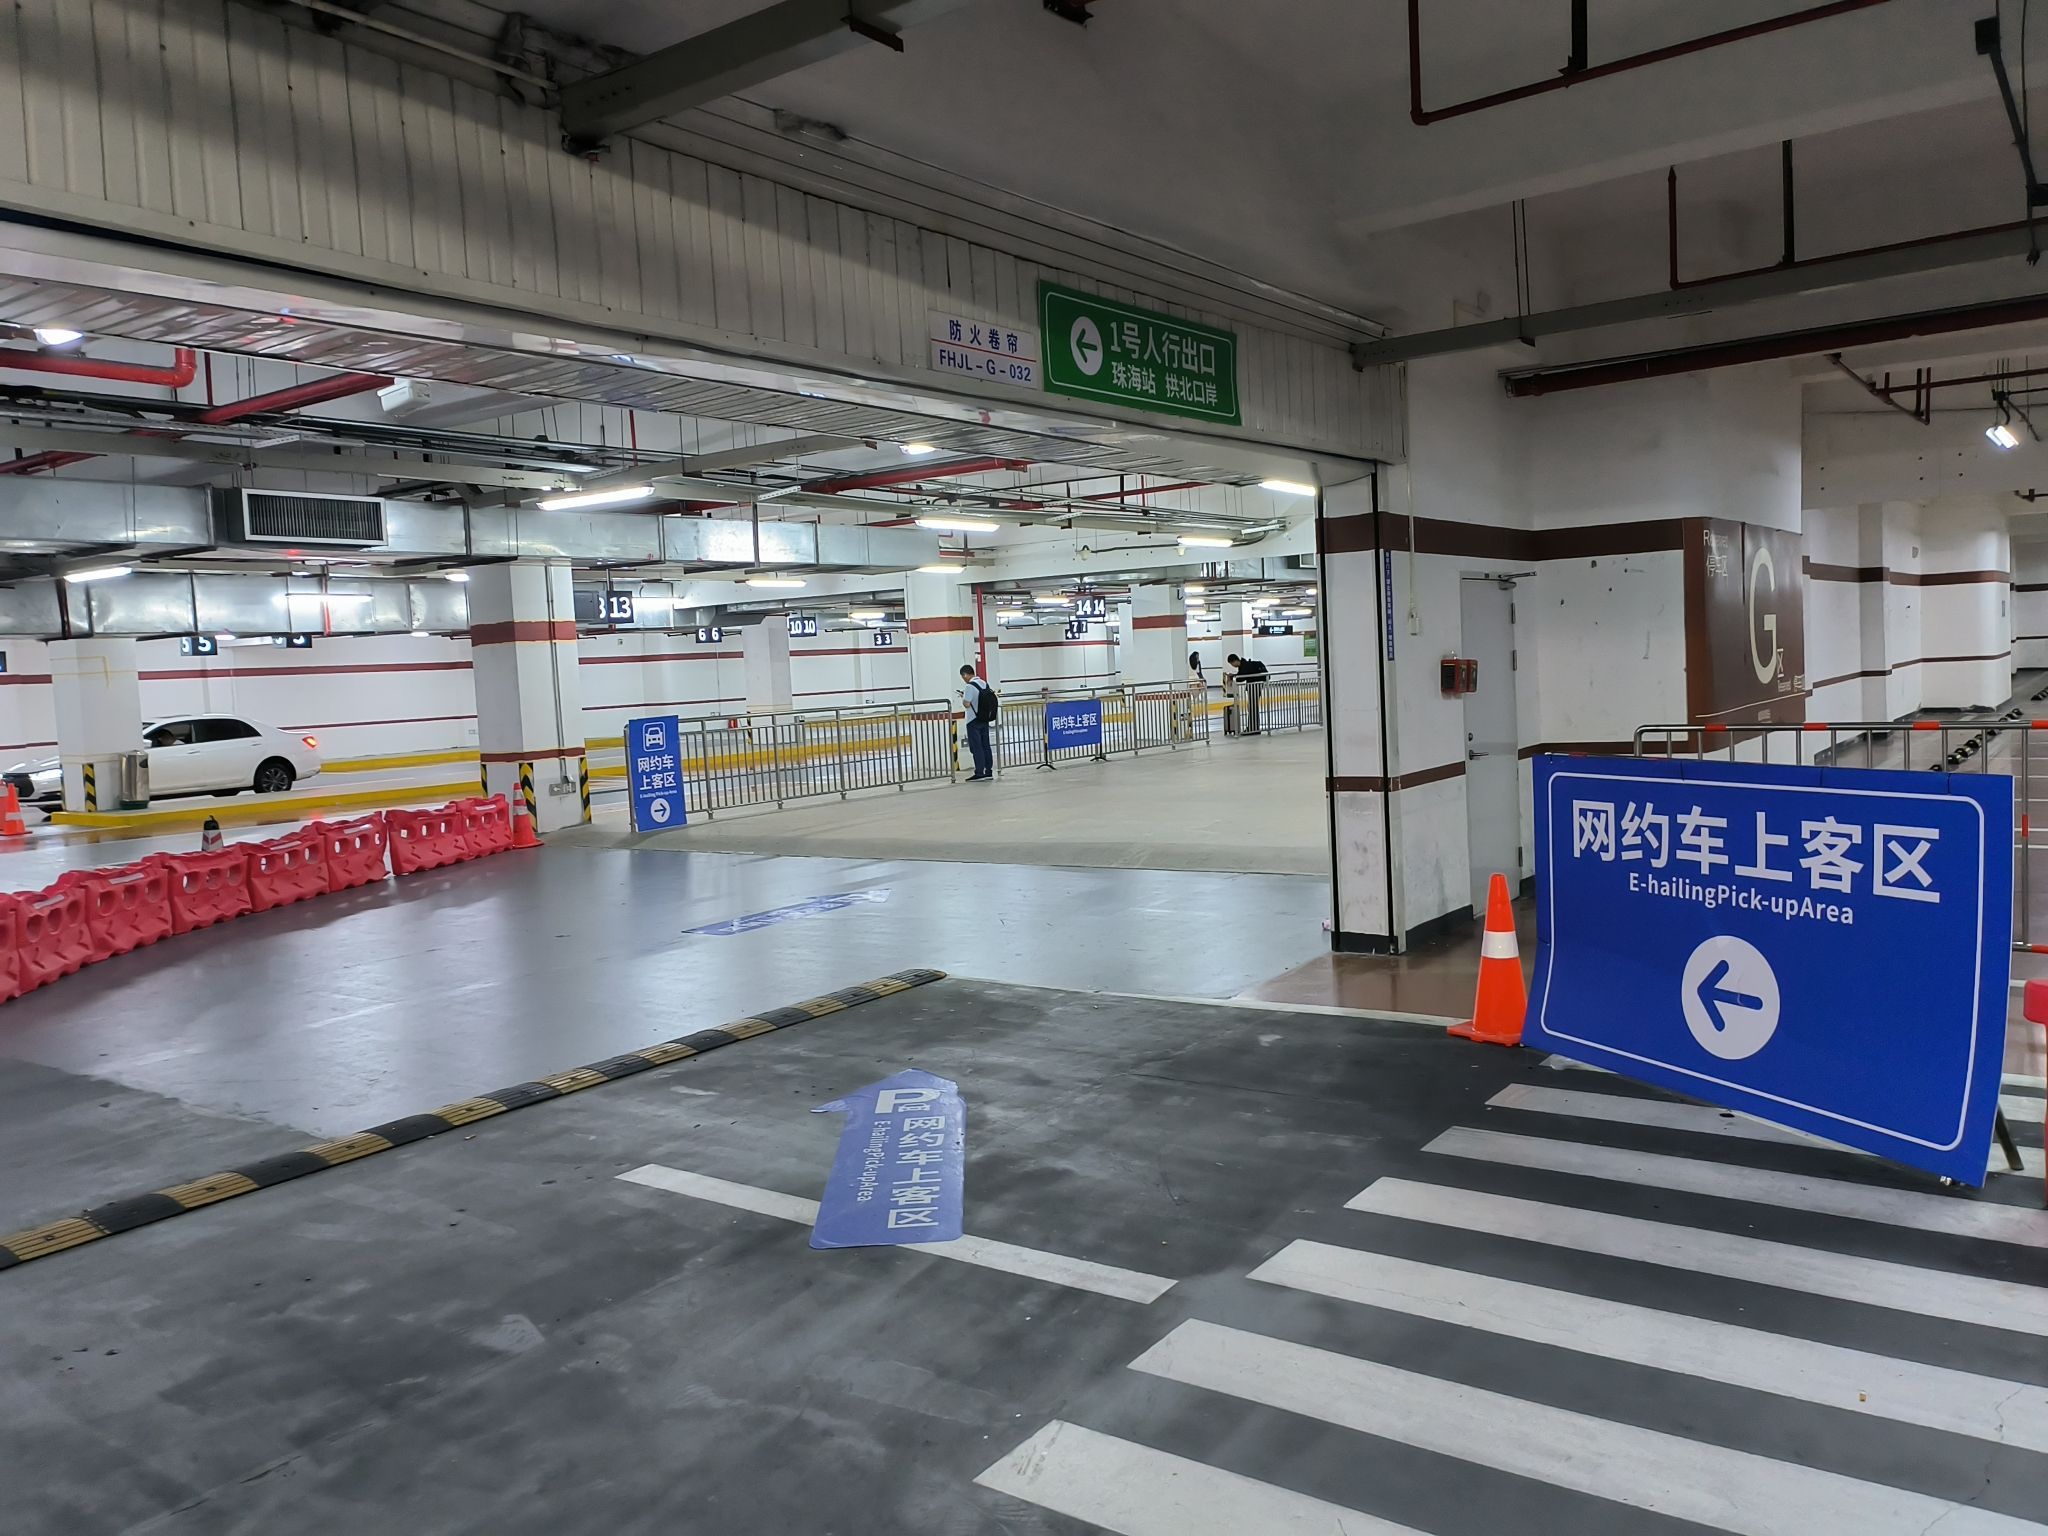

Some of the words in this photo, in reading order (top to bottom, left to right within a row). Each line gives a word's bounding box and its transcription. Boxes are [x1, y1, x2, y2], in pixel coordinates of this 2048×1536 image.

[949, 320, 1018, 354] 防火卷帘
[1110, 321, 1215, 377] 1号人行出口
[940, 349, 1032, 382] FHJL-G-032
[1112, 361, 1156, 395] 珠海站
[1165, 372, 1218, 407] 拱北口岸
[610, 597, 631, 618] 13
[1076, 600, 1092, 615] 14
[1094, 600, 1105, 615] 14
[1750, 547, 1777, 684] G
[699, 628, 706, 641] 6
[712, 627, 719, 641] 6
[790, 621, 802, 634] 10
[804, 620, 815, 634] 10
[1072, 622, 1078, 632] 7
[876, 635, 882, 645] 3
[885, 634, 891, 644] 3
[1052, 713, 1097, 730] 网约车上客区
[638, 754, 674, 773] 网约车
[640, 772, 676, 790] 上客区
[1573, 799, 1940, 904] 网约车上客区
[1629, 873, 1854, 925] E-hailingPick-upArea
[875, 1088, 942, 1114] P
[887, 1115, 946, 1229] 网约车上客区
